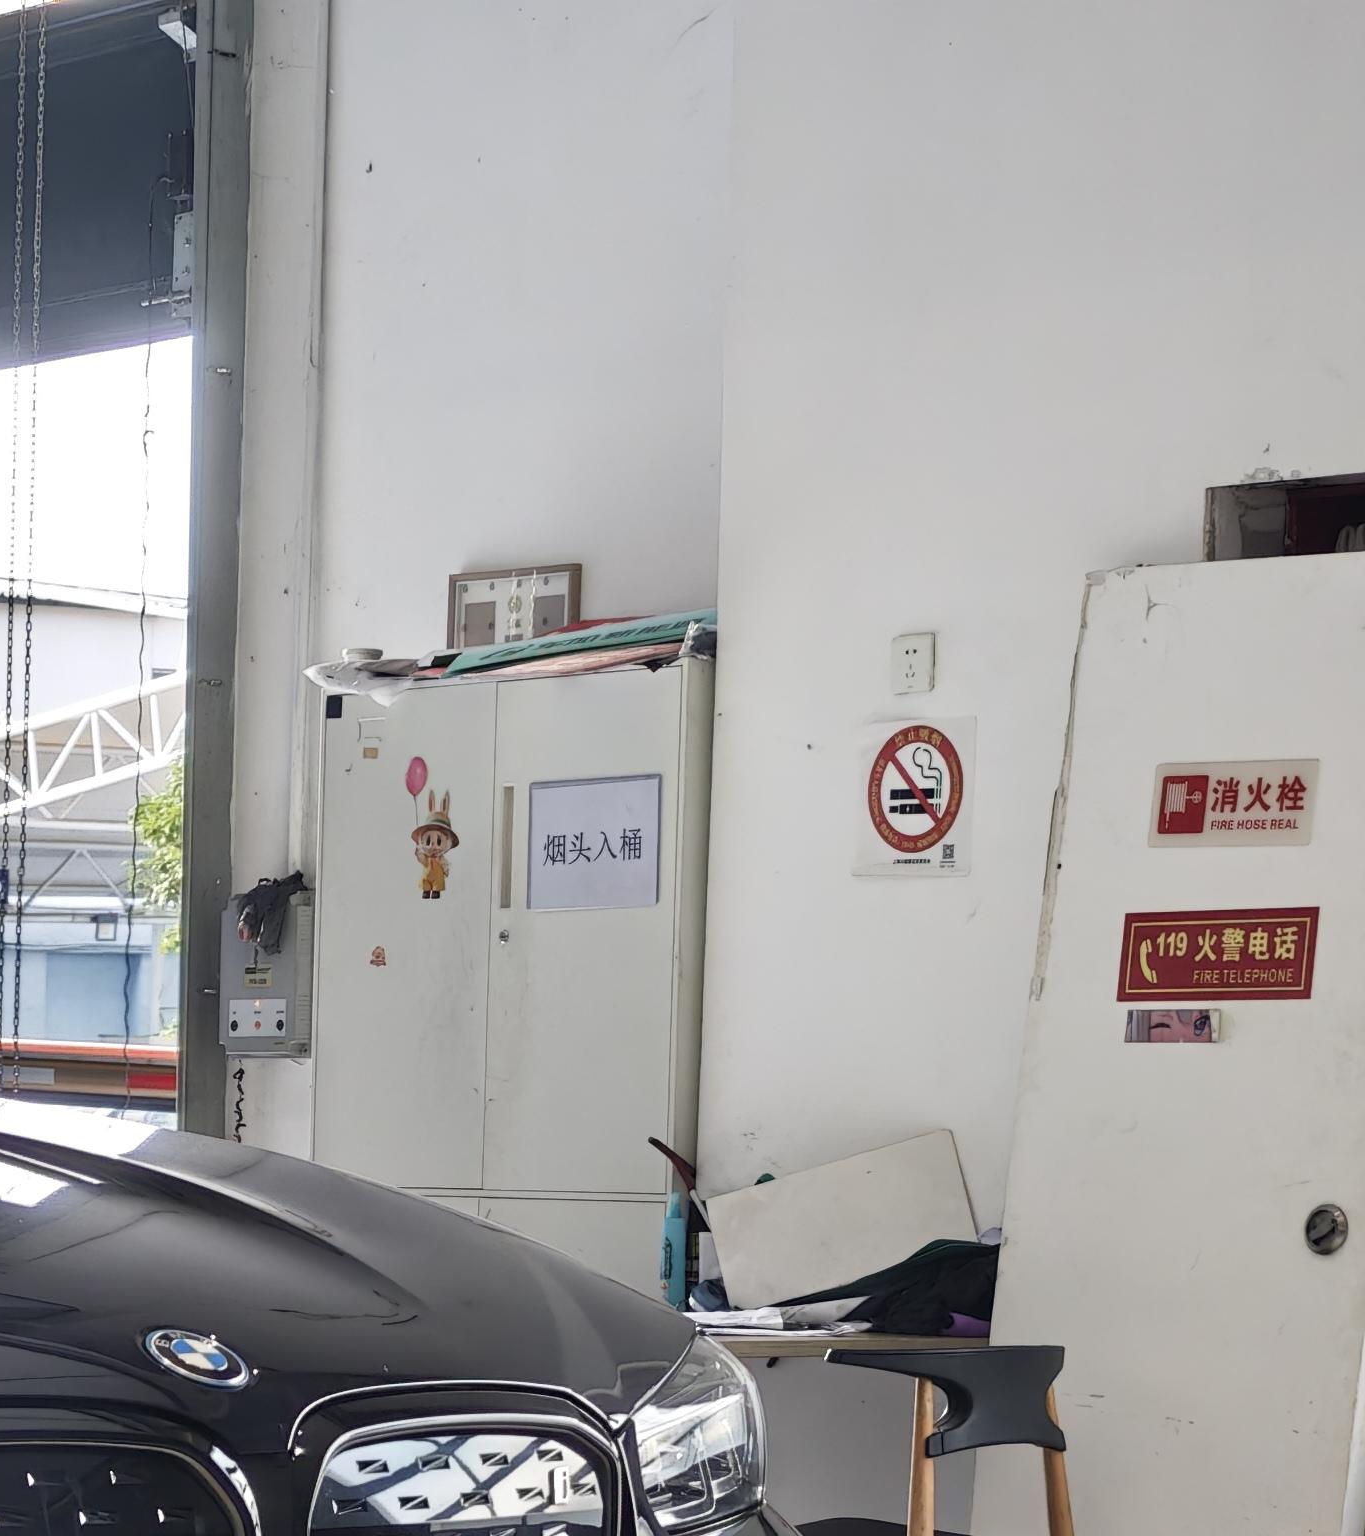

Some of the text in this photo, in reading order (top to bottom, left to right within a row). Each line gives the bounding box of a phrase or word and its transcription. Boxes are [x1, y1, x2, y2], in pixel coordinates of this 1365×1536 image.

[1210, 776, 1307, 813] 消火栓
[1210, 820, 1234, 830] FIRE
[1236, 820, 1268, 830] HOSE
[543, 828, 642, 866] 烟头入桶
[1156, 926, 1299, 962] 119 火警电话
[1193, 968, 1295, 984] FIRE TELEPHONE
